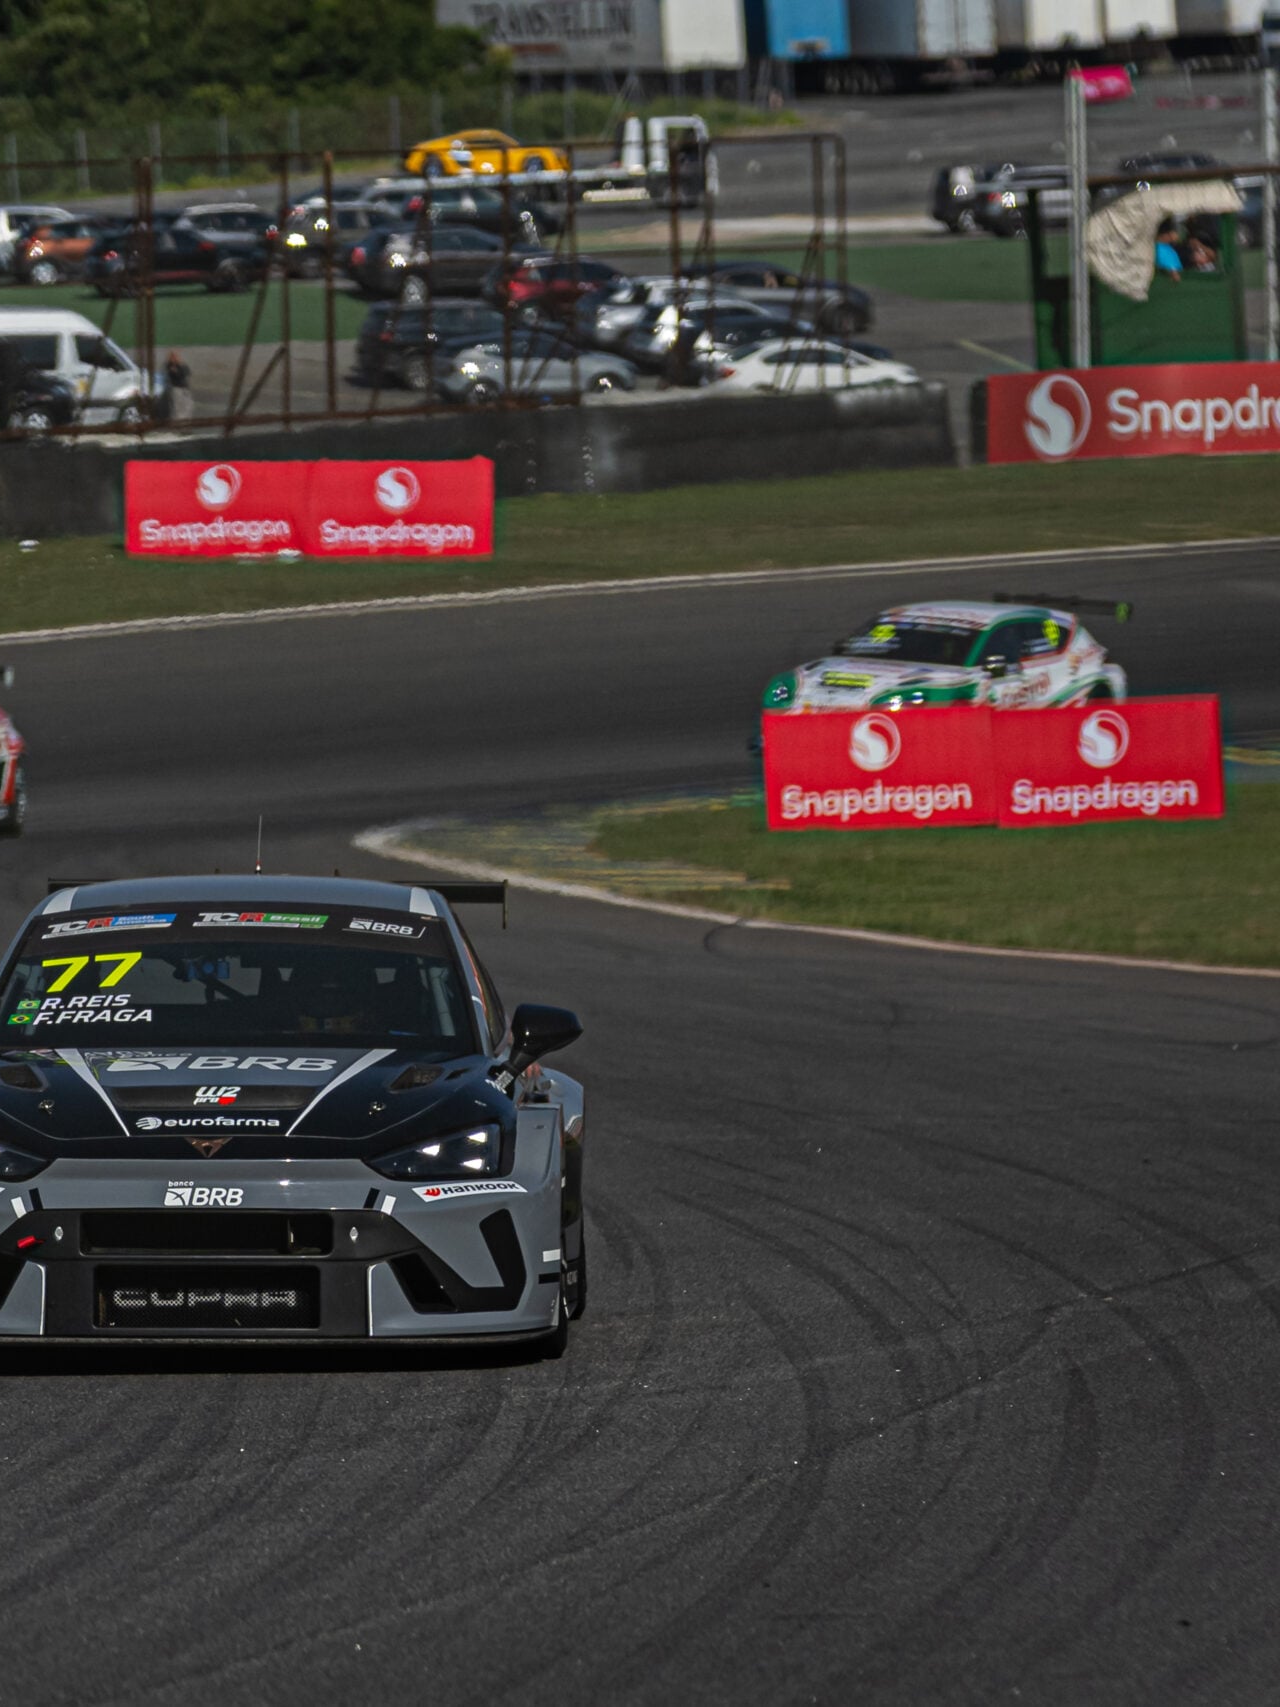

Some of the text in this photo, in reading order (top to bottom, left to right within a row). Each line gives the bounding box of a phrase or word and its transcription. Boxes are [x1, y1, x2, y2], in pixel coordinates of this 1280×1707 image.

[139, 516, 290, 549] Snapdragon
[320, 518, 474, 551] Snapdragon
[781, 779, 973, 821] Snapdragon
[1011, 775, 1198, 817] Snapdragon
[48, 916, 114, 933] TCR
[199, 912, 265, 923] TCR
[270, 914, 321, 923] Brasil
[371, 922, 414, 935] BRB
[42, 952, 142, 993] 77
[40, 994, 131, 1010] R.REIS
[33, 1009, 152, 1026] F.FRAGA
[187, 1055, 337, 1072] BRB
[164, 1116, 280, 1128] eurofarma
[168, 1180, 195, 1188] banco
[192, 1187, 244, 1206] BRB
